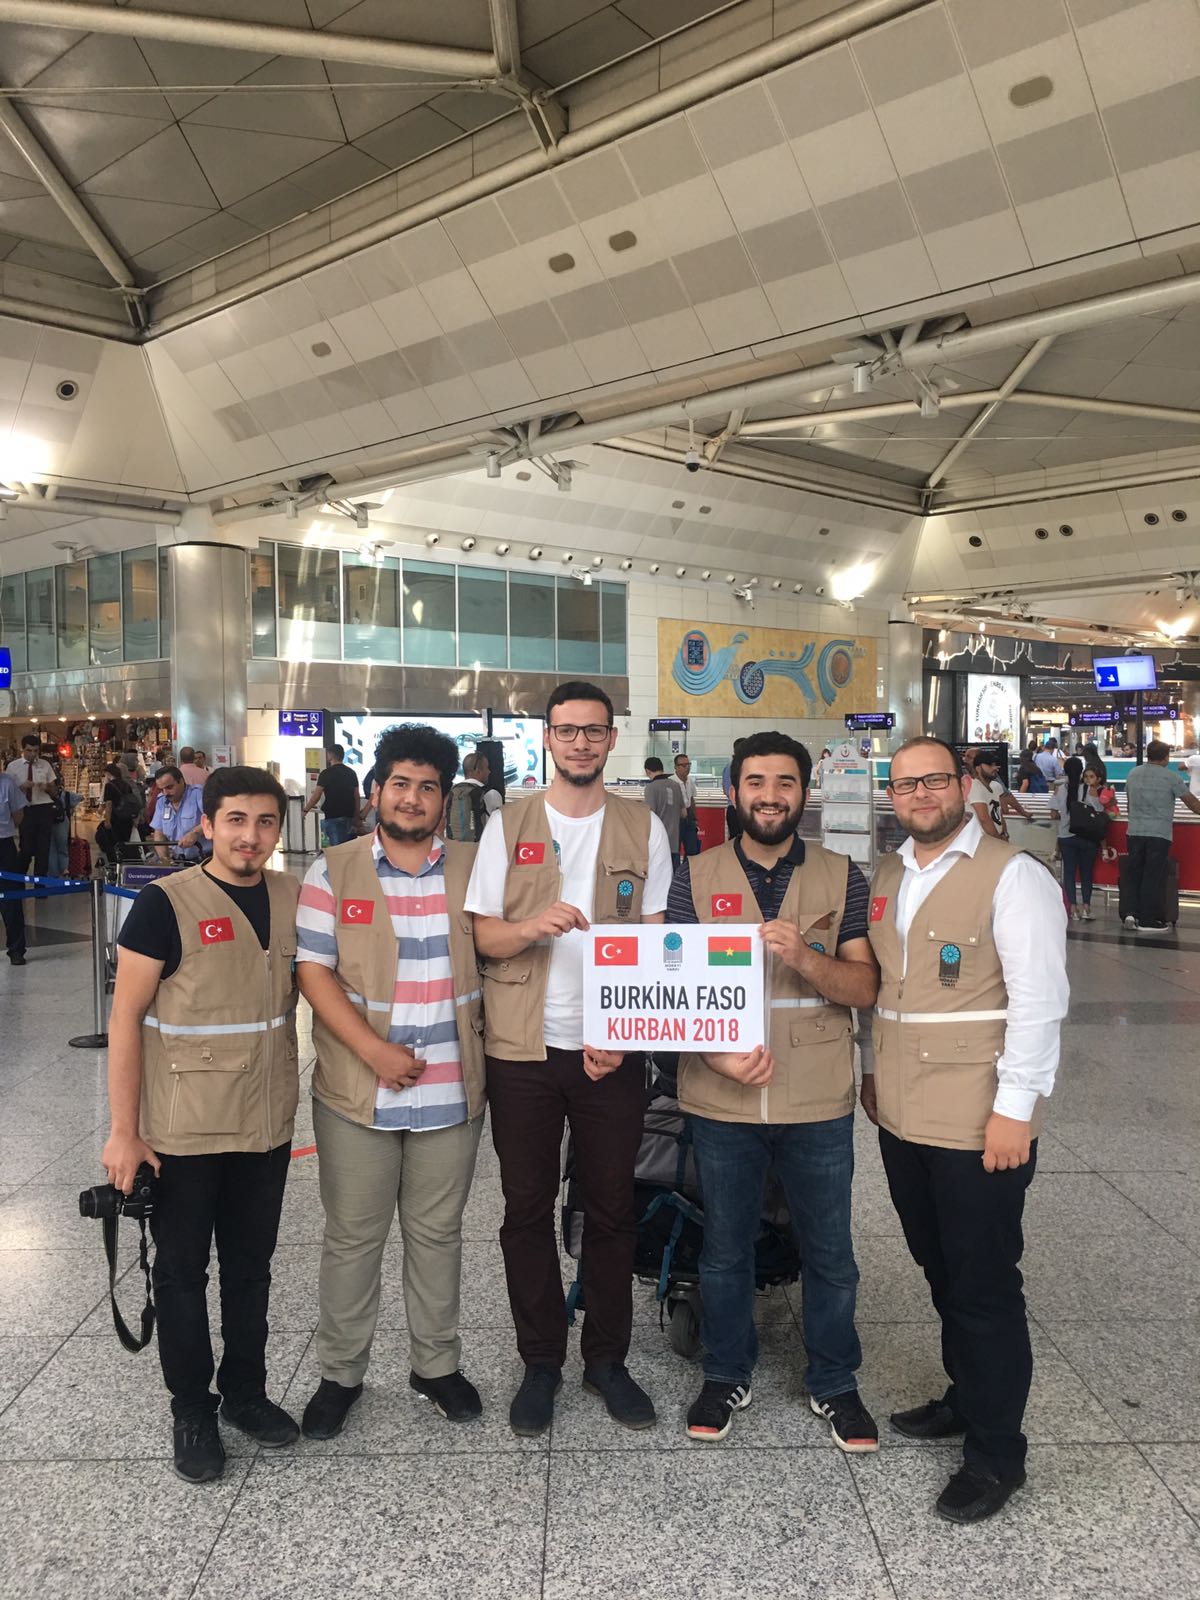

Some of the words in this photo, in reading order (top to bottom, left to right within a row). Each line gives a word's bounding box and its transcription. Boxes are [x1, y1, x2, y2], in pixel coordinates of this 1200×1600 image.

[1114, 711, 1120, 720] 8
[1170, 710, 1176, 719] 9
[887, 717, 892, 726] 5
[1070, 717, 1076, 725] 6
[298, 724, 304, 734] 1
[600, 981, 690, 1010] BURKİNA
[696, 985, 746, 1010] FASO
[607, 1017, 686, 1042] KURBAN
[692, 1018, 739, 1042] 2018
